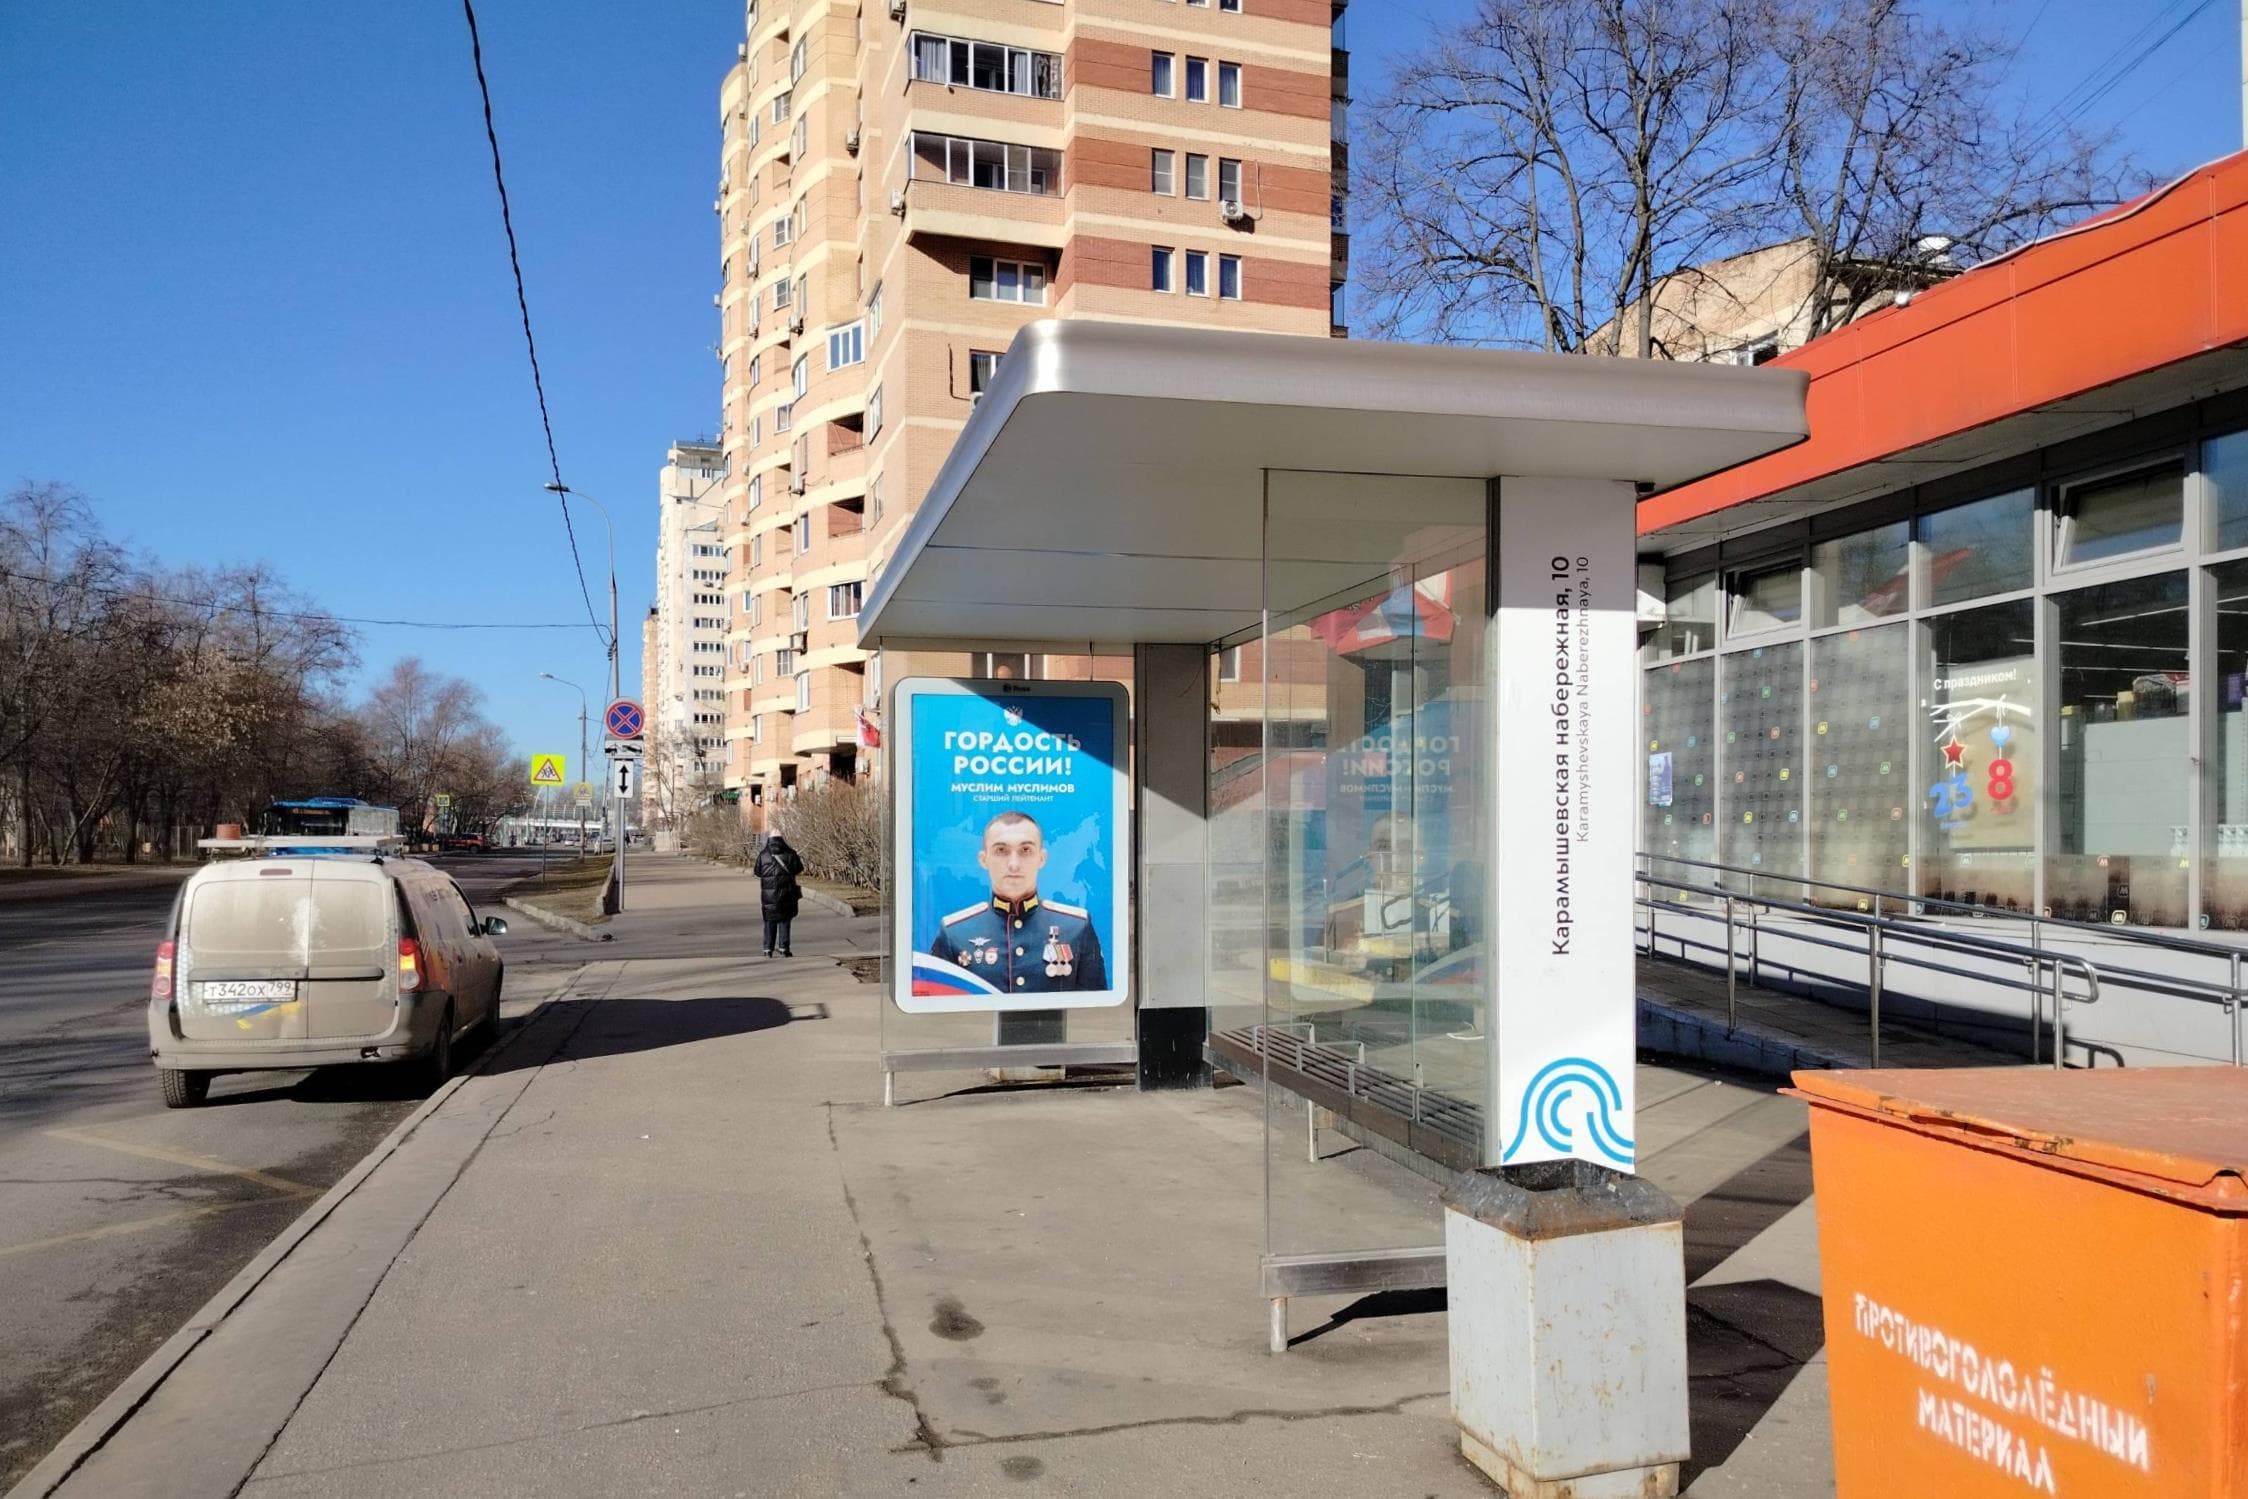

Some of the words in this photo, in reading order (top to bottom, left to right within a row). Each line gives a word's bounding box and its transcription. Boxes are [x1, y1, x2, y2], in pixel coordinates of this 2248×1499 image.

[1551, 556, 1569, 580] 10
[1576, 556, 1589, 573] 10
[1576, 578, 1592, 696] Naberezhnaya,
[1551, 588, 1573, 745] набережная,
[1933, 678, 1942, 690] С
[1943, 668, 2017, 691] праздником!
[944, 731, 1081, 753] ГОРДОСТЬ
[953, 755, 1073, 776] РОССИИ!
[1576, 702, 1592, 843] Karamyshevskaya
[1987, 759, 2015, 800] 8
[951, 782, 1003, 793] МУСЛИМ
[1007, 783, 1075, 793] МУСЛИМОВ
[1552, 753, 1573, 956] Карамышевская
[1917, 1386, 2056, 1496] МАТЕРИАЛ
